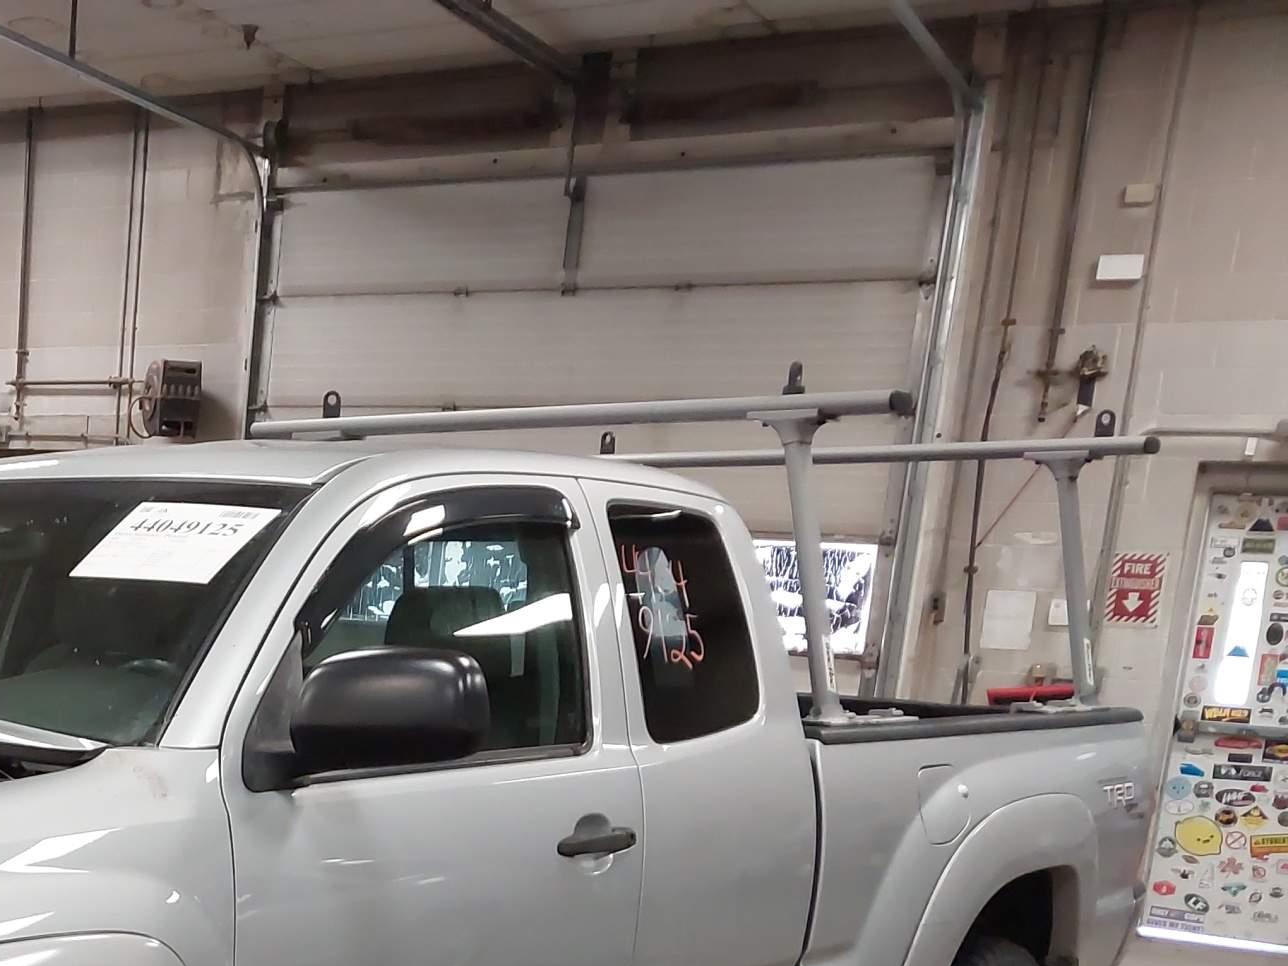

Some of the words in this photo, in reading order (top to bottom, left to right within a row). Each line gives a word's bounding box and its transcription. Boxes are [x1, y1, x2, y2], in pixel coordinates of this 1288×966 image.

[130, 518, 245, 537] 44049125
[1123, 562, 1153, 575] FIRE
[638, 606, 706, 670] 9125
[1103, 782, 1135, 809] TRD
